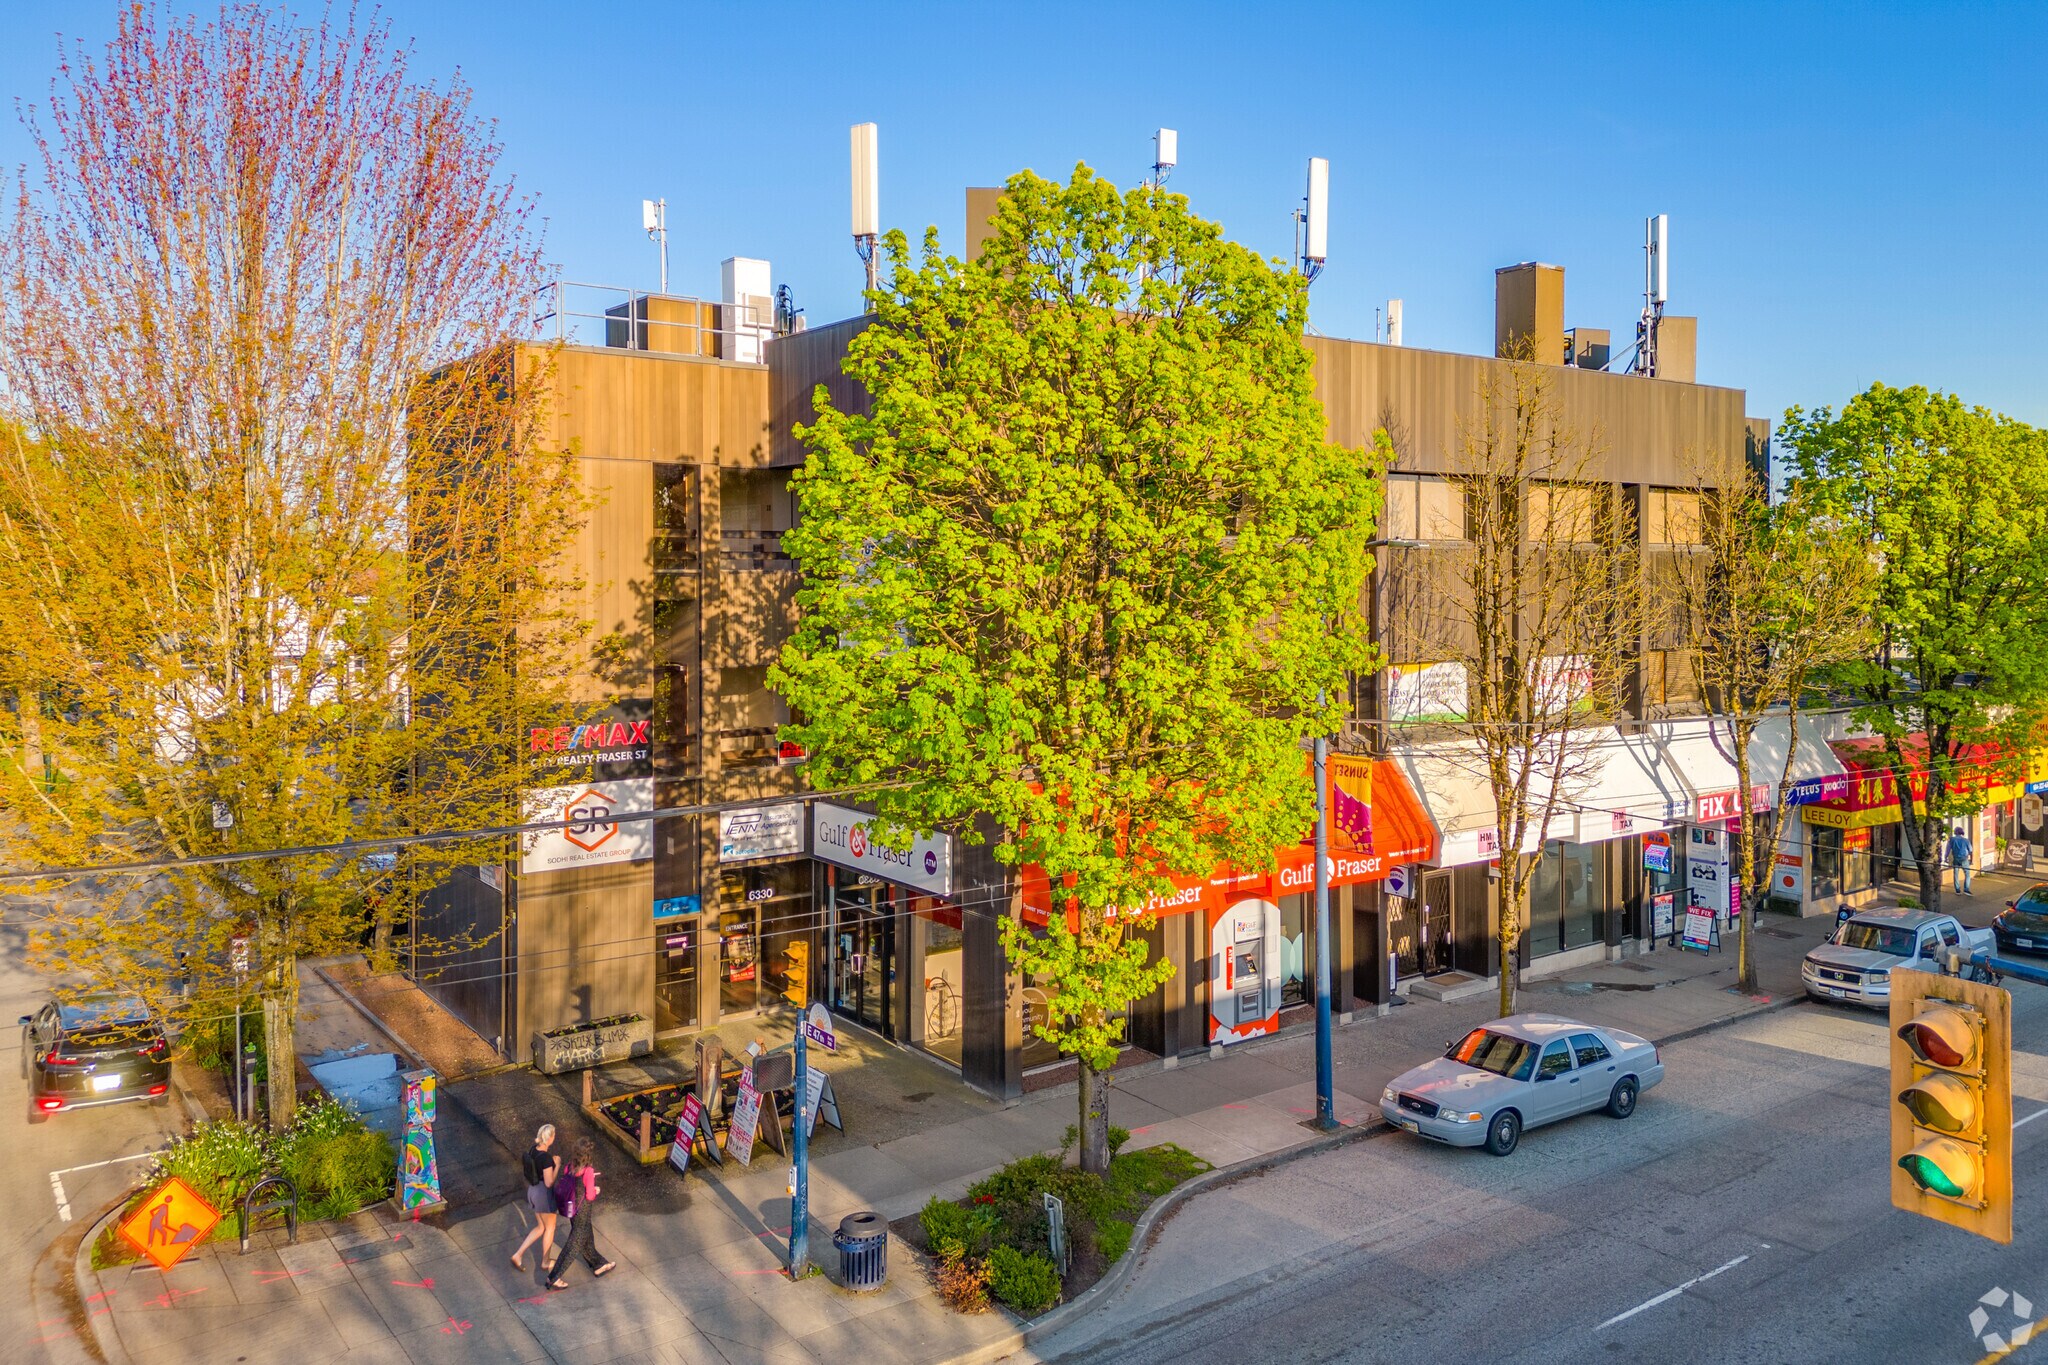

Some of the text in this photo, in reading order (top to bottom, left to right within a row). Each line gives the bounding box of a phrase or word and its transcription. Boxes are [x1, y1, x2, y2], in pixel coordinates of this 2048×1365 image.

[530, 720, 650, 752] RE/MAX
[557, 754, 594, 766] REALTY
[596, 751, 633, 763] FRASER
[635, 749, 648, 760] ST
[1796, 783, 1820, 797] TELUS
[569, 806, 610, 835] SR
[764, 813, 791, 821] Insurance
[1805, 809, 1851, 826] LEE LOY
[761, 821, 787, 830] Agencies
[1620, 819, 1632, 829] TAX
[819, 821, 848, 848] Gulf
[1480, 832, 1492, 842] HM
[609, 849, 632, 857] GROUP
[925, 857, 936, 868] ATM
[1280, 857, 1382, 887] Gulf Fraser
[748, 888, 773, 901] 6330
[1148, 886, 1202, 910] Fraser
[1689, 907, 1712, 918] WE FIX
[725, 922, 748, 932] ENTRANCE
[807, 1025, 812, 1037] E
[813, 1028, 825, 1044] 47th
